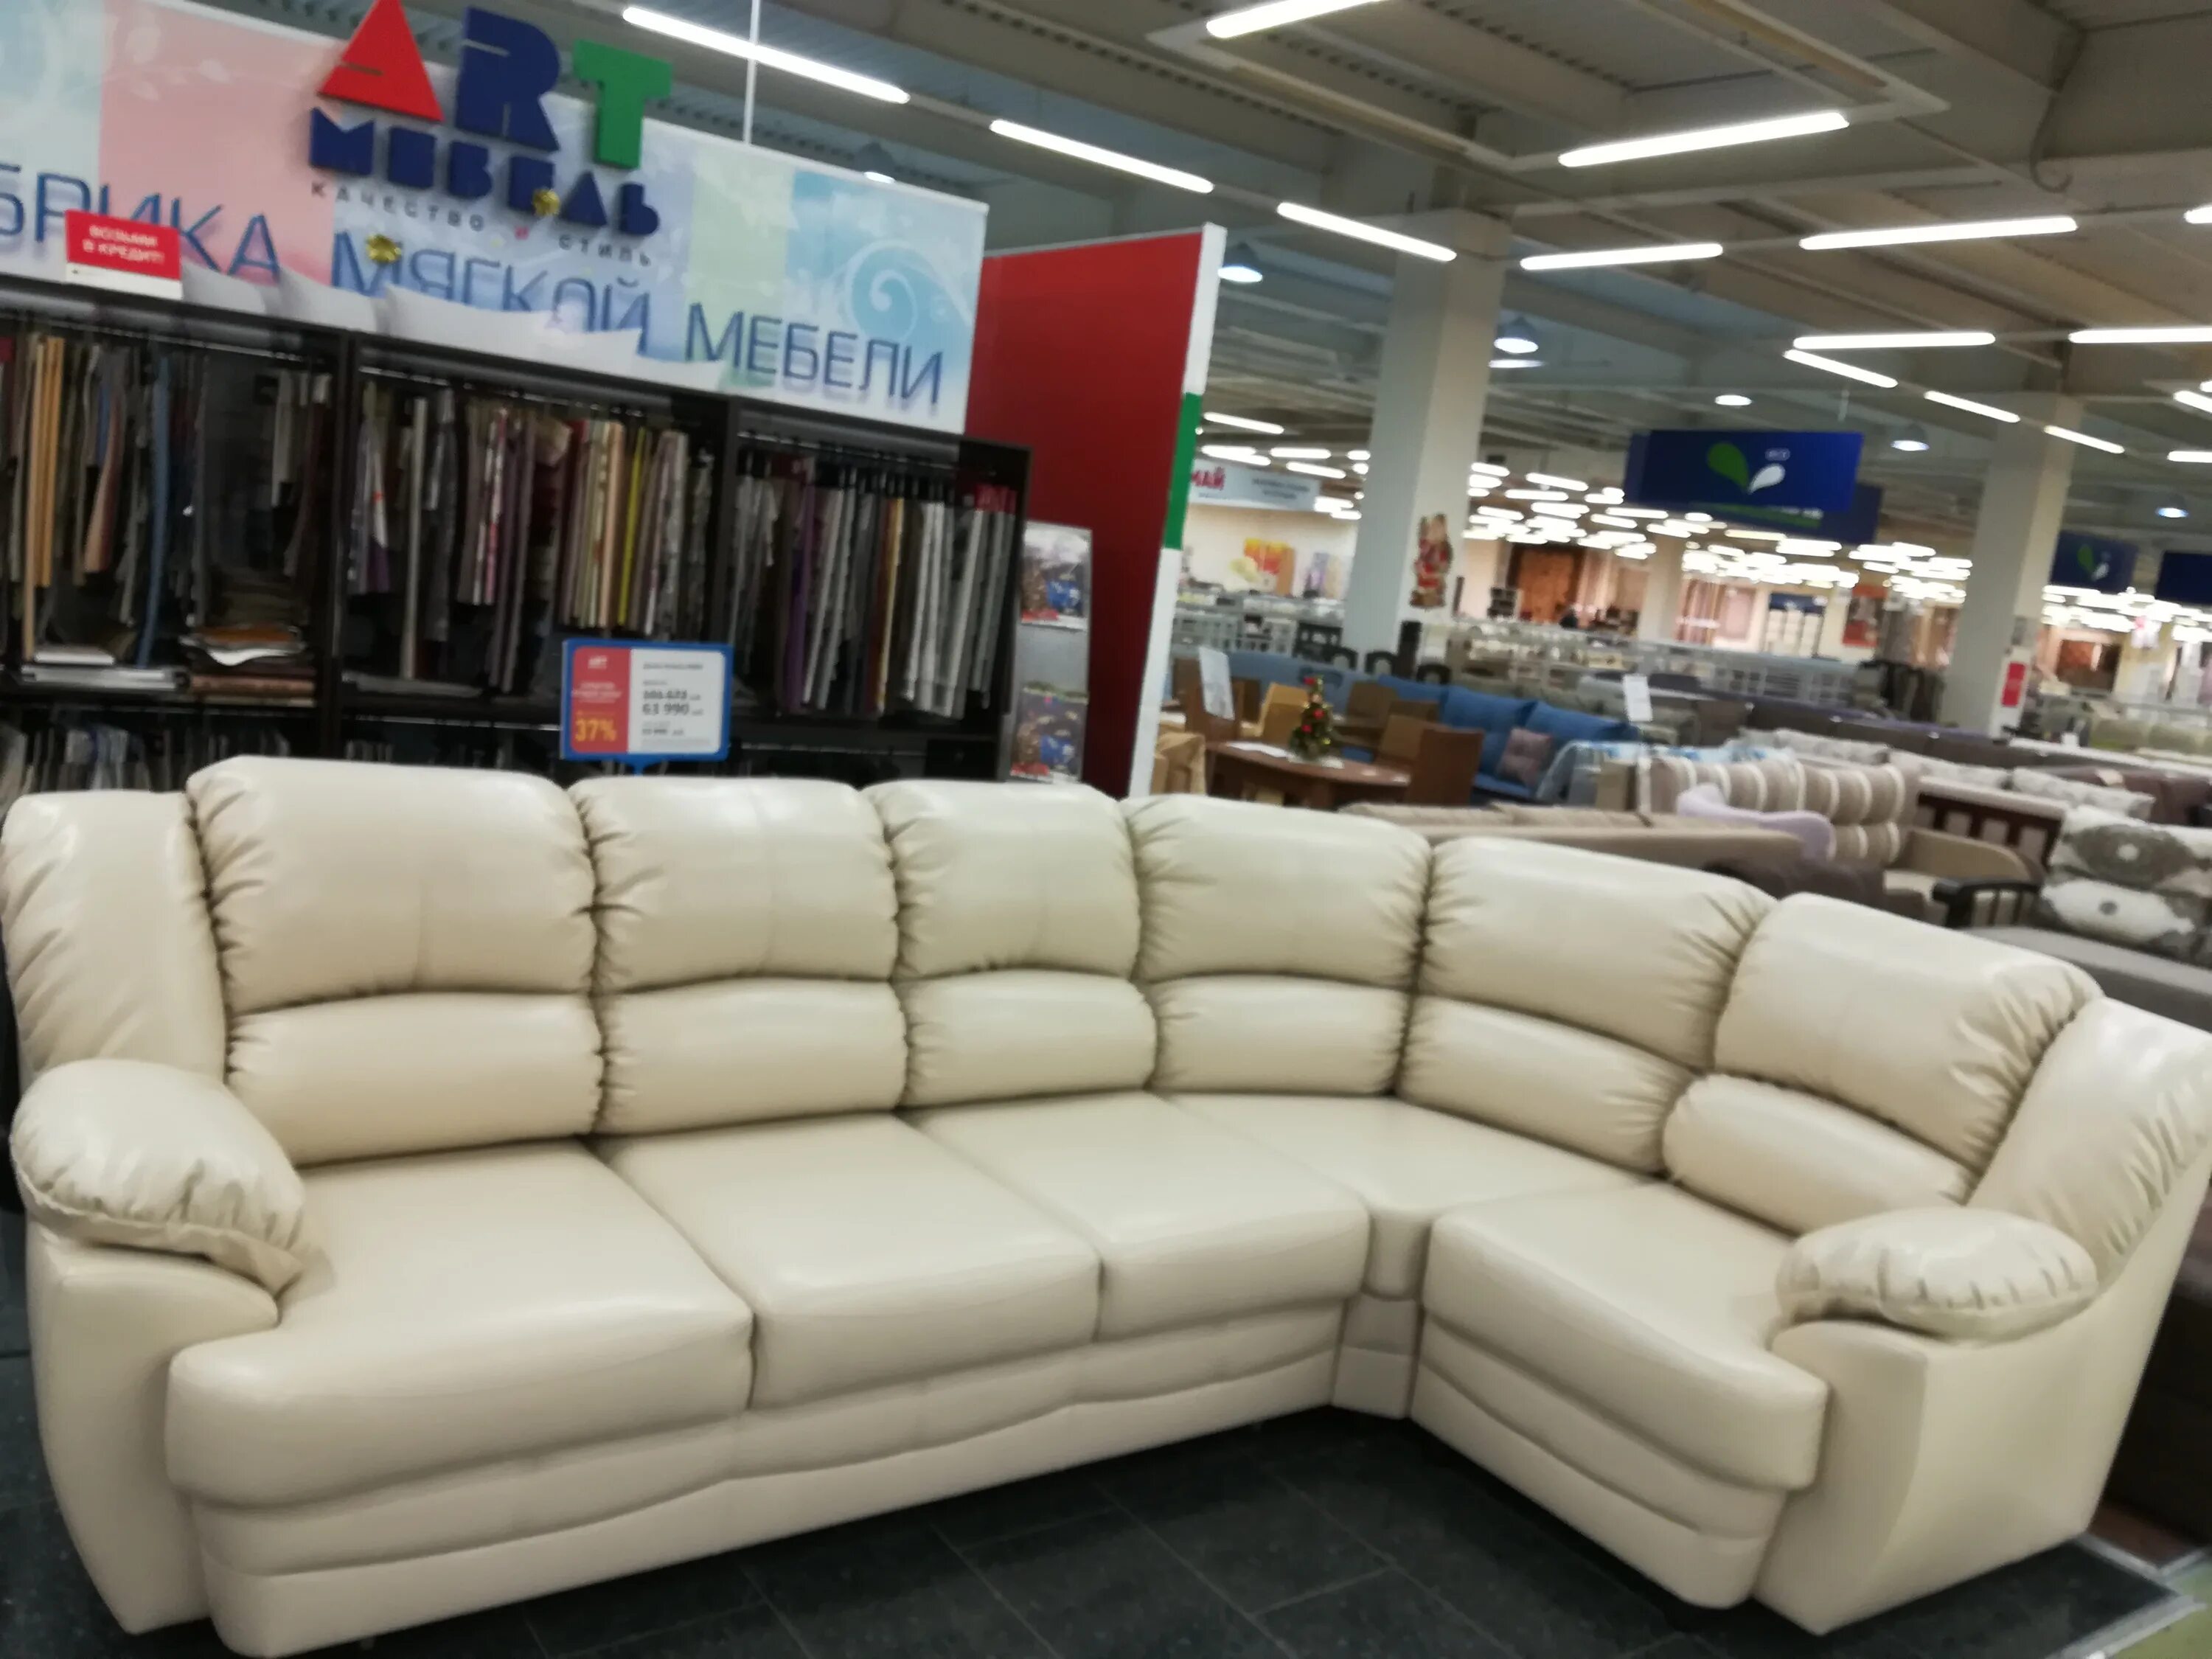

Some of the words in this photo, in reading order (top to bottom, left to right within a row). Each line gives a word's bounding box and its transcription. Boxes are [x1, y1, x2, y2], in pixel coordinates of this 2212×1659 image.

[317, 0, 675, 170] ART
[310, 181, 485, 232] КАЧЕСТВО
[558, 234, 653, 268] СТИЛЬ
[684, 302, 943, 406] МЕБЕЛИ
